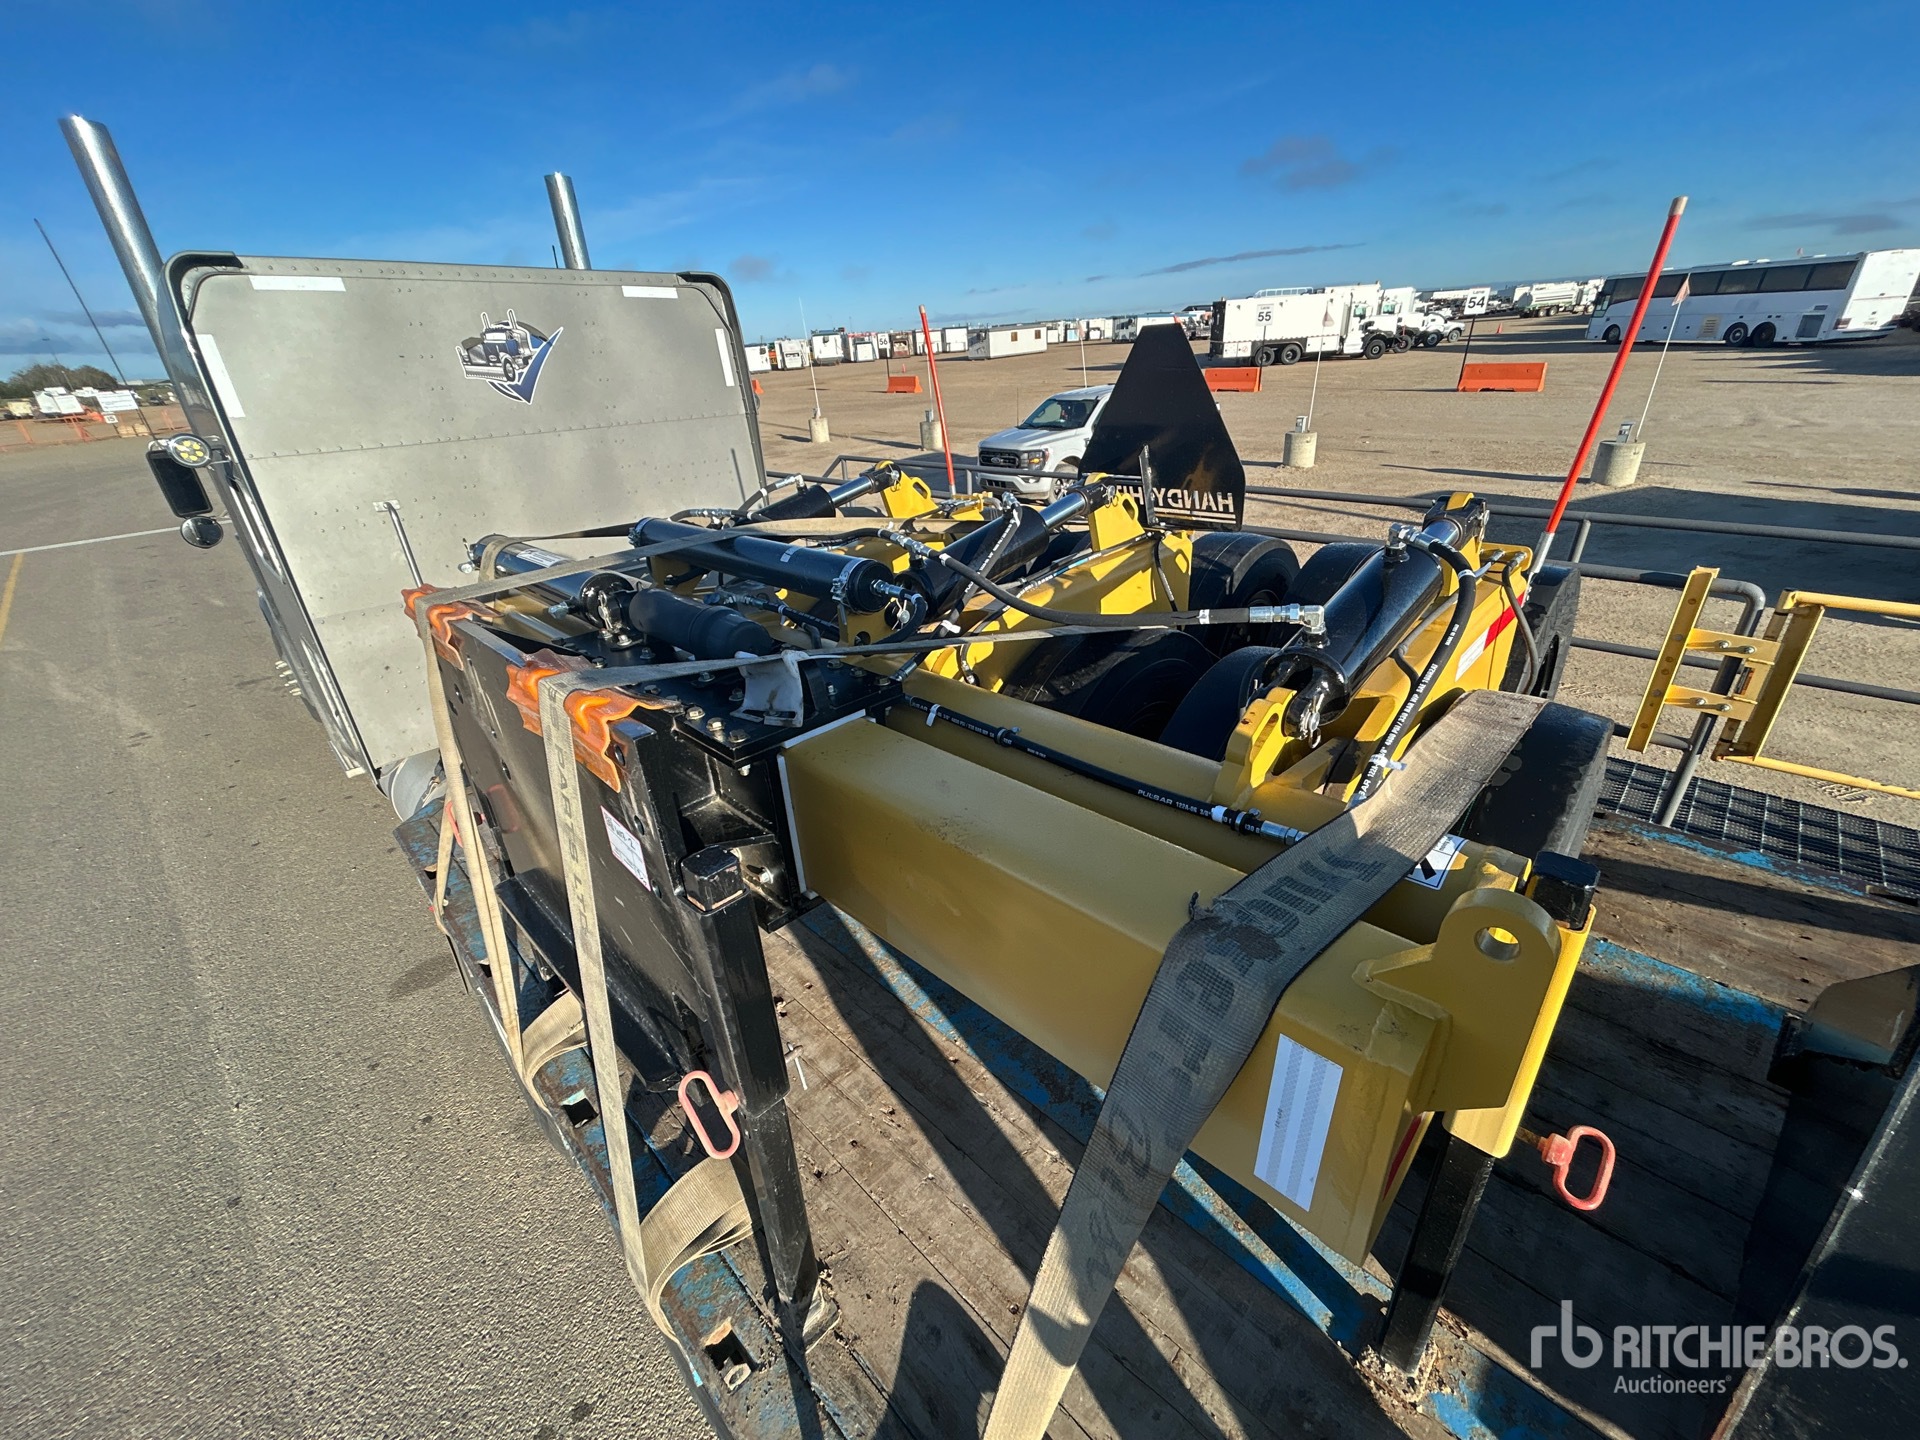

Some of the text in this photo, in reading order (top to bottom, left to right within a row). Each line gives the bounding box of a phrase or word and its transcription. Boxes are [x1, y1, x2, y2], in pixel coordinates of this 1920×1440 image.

[1467, 296, 1486, 309] 54
[1257, 311, 1272, 322] 55
[555, 743, 579, 864] PARTS
[1138, 789, 1173, 805] PULSAR
